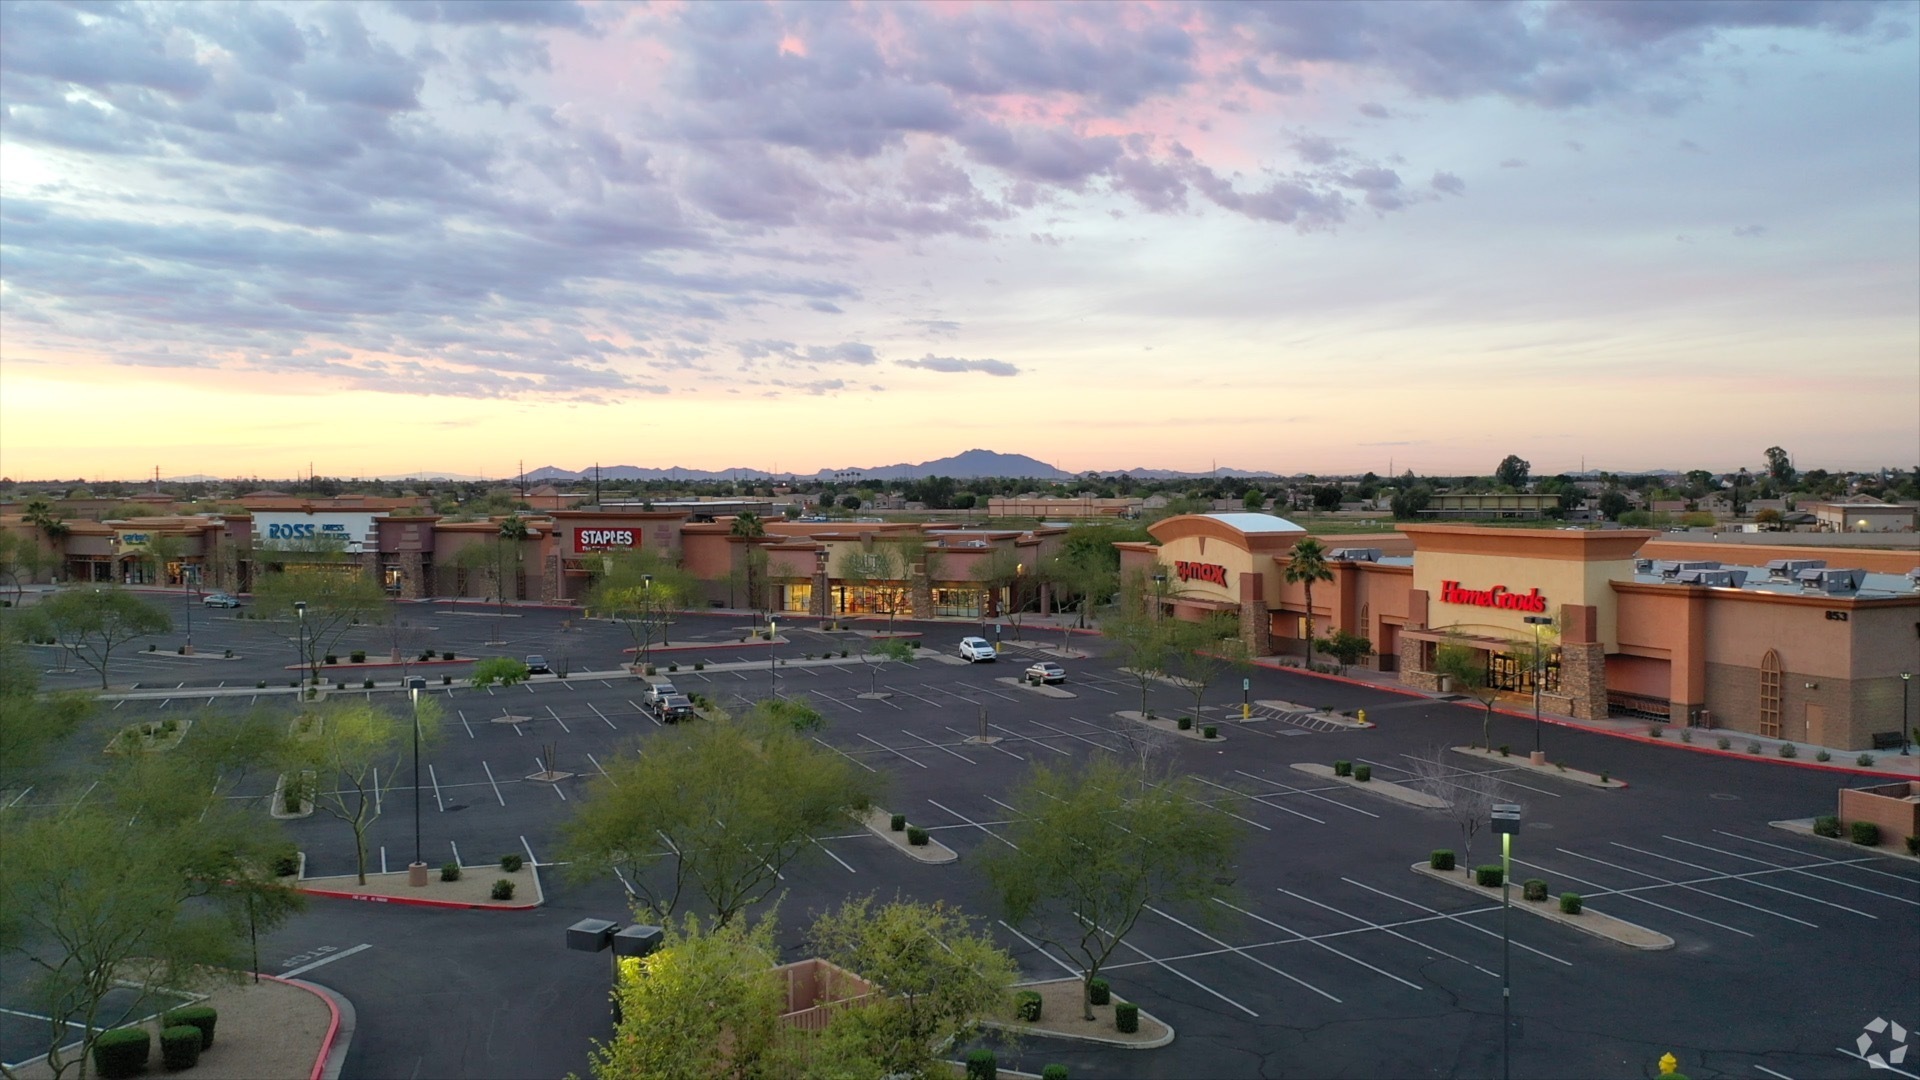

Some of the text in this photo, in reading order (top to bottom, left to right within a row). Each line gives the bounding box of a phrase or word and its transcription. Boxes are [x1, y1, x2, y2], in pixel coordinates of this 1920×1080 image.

[269, 523, 315, 541] ROSS
[581, 530, 633, 545] STAPLES
[1440, 580, 1546, 613] HomeGoods
[1825, 610, 1848, 622] 853
[282, 945, 338, 967] STOP
